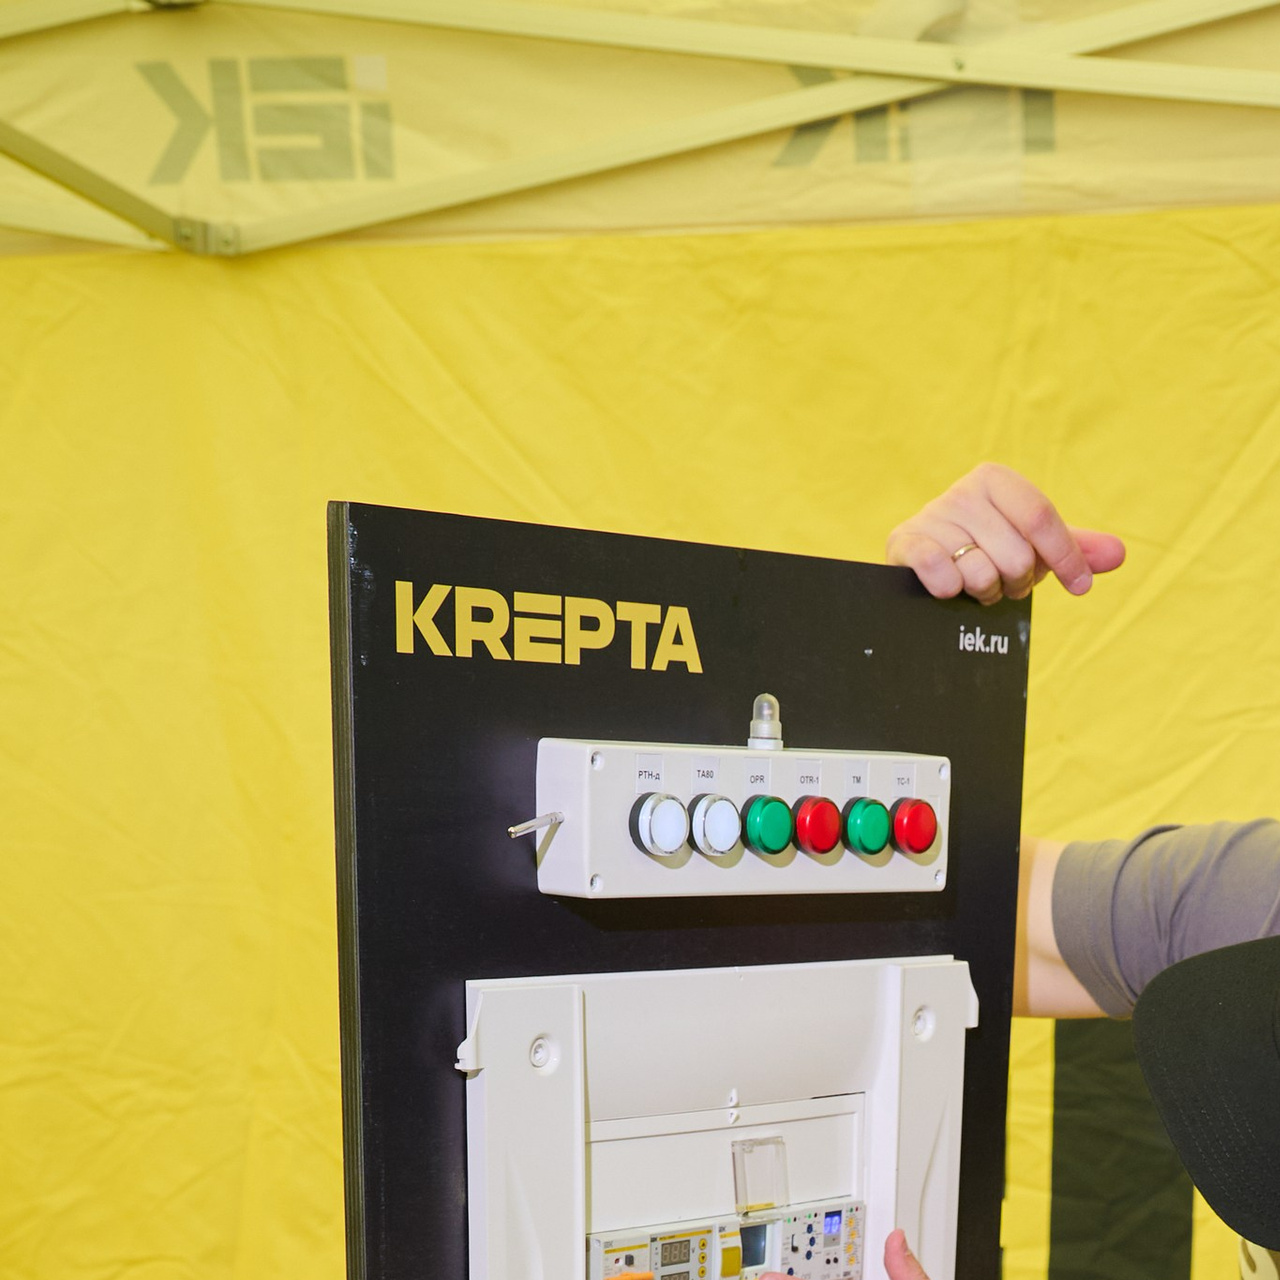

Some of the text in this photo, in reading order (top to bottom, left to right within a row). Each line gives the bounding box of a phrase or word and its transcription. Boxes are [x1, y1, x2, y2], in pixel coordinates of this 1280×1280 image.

[395, 580, 704, 674] KREPTA
[958, 624, 1010, 655] iek.ru
[749, 774, 765, 784] OPR
